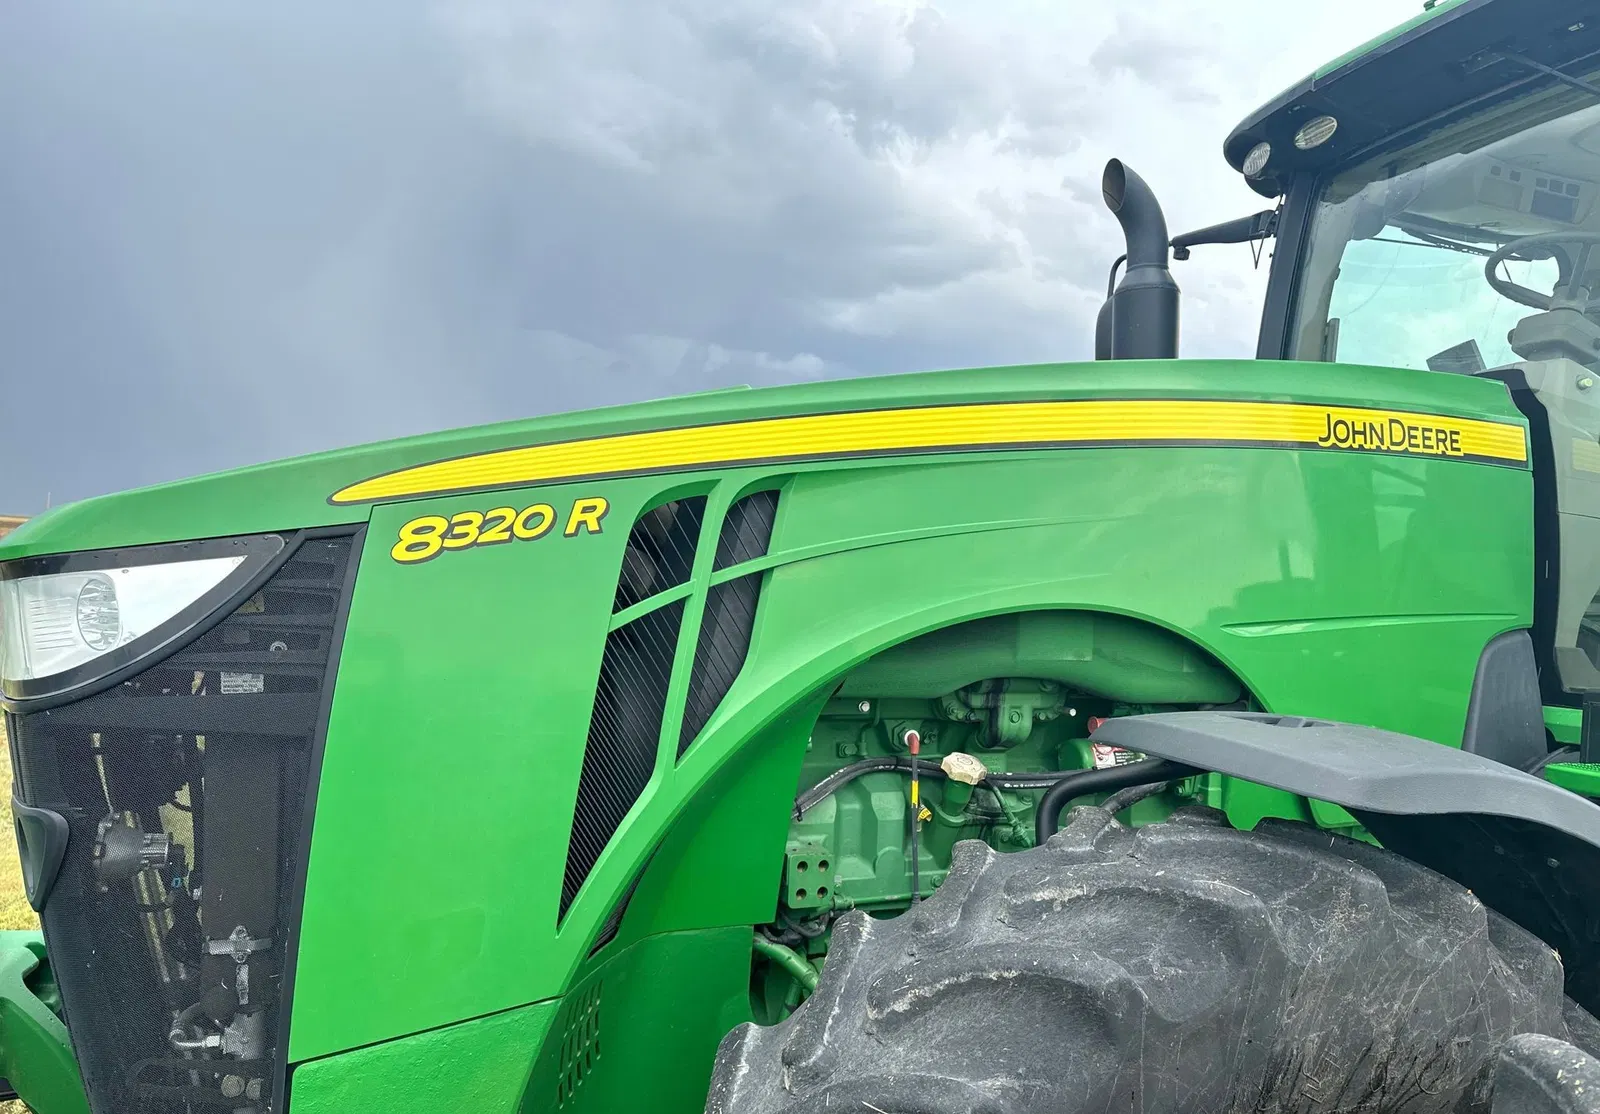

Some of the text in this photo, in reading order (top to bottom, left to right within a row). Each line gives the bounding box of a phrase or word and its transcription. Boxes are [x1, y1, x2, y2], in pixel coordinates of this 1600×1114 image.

[1318, 413, 1462, 453] JOHN DEERE
[390, 496, 610, 565] 8320 R
